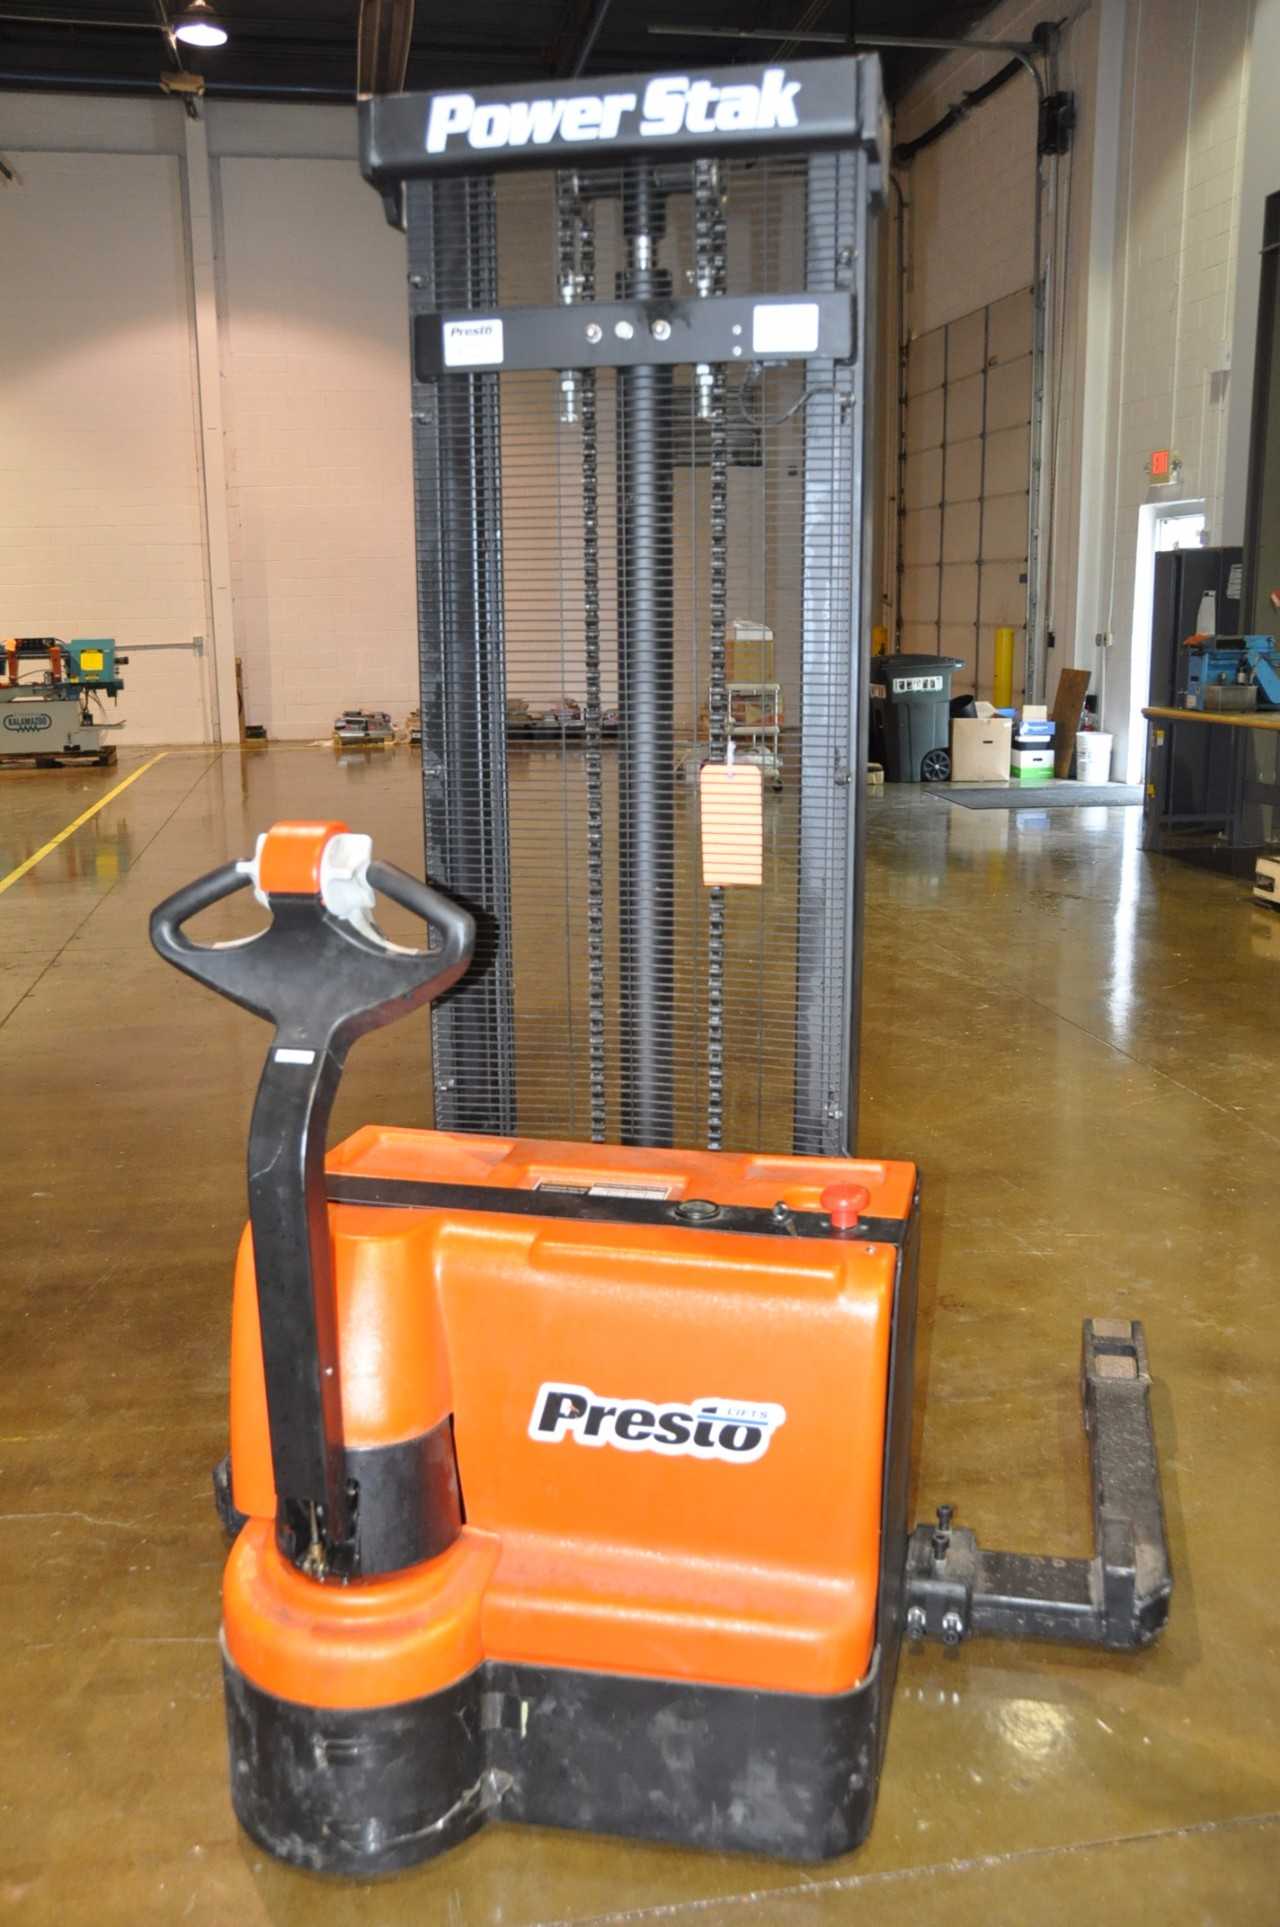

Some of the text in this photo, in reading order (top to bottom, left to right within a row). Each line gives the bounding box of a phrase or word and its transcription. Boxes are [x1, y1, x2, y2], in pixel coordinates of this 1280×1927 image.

[450, 326, 493, 337] Presto
[727, 1407, 769, 1418] LIFTS
[538, 1391, 762, 1452] Presto
